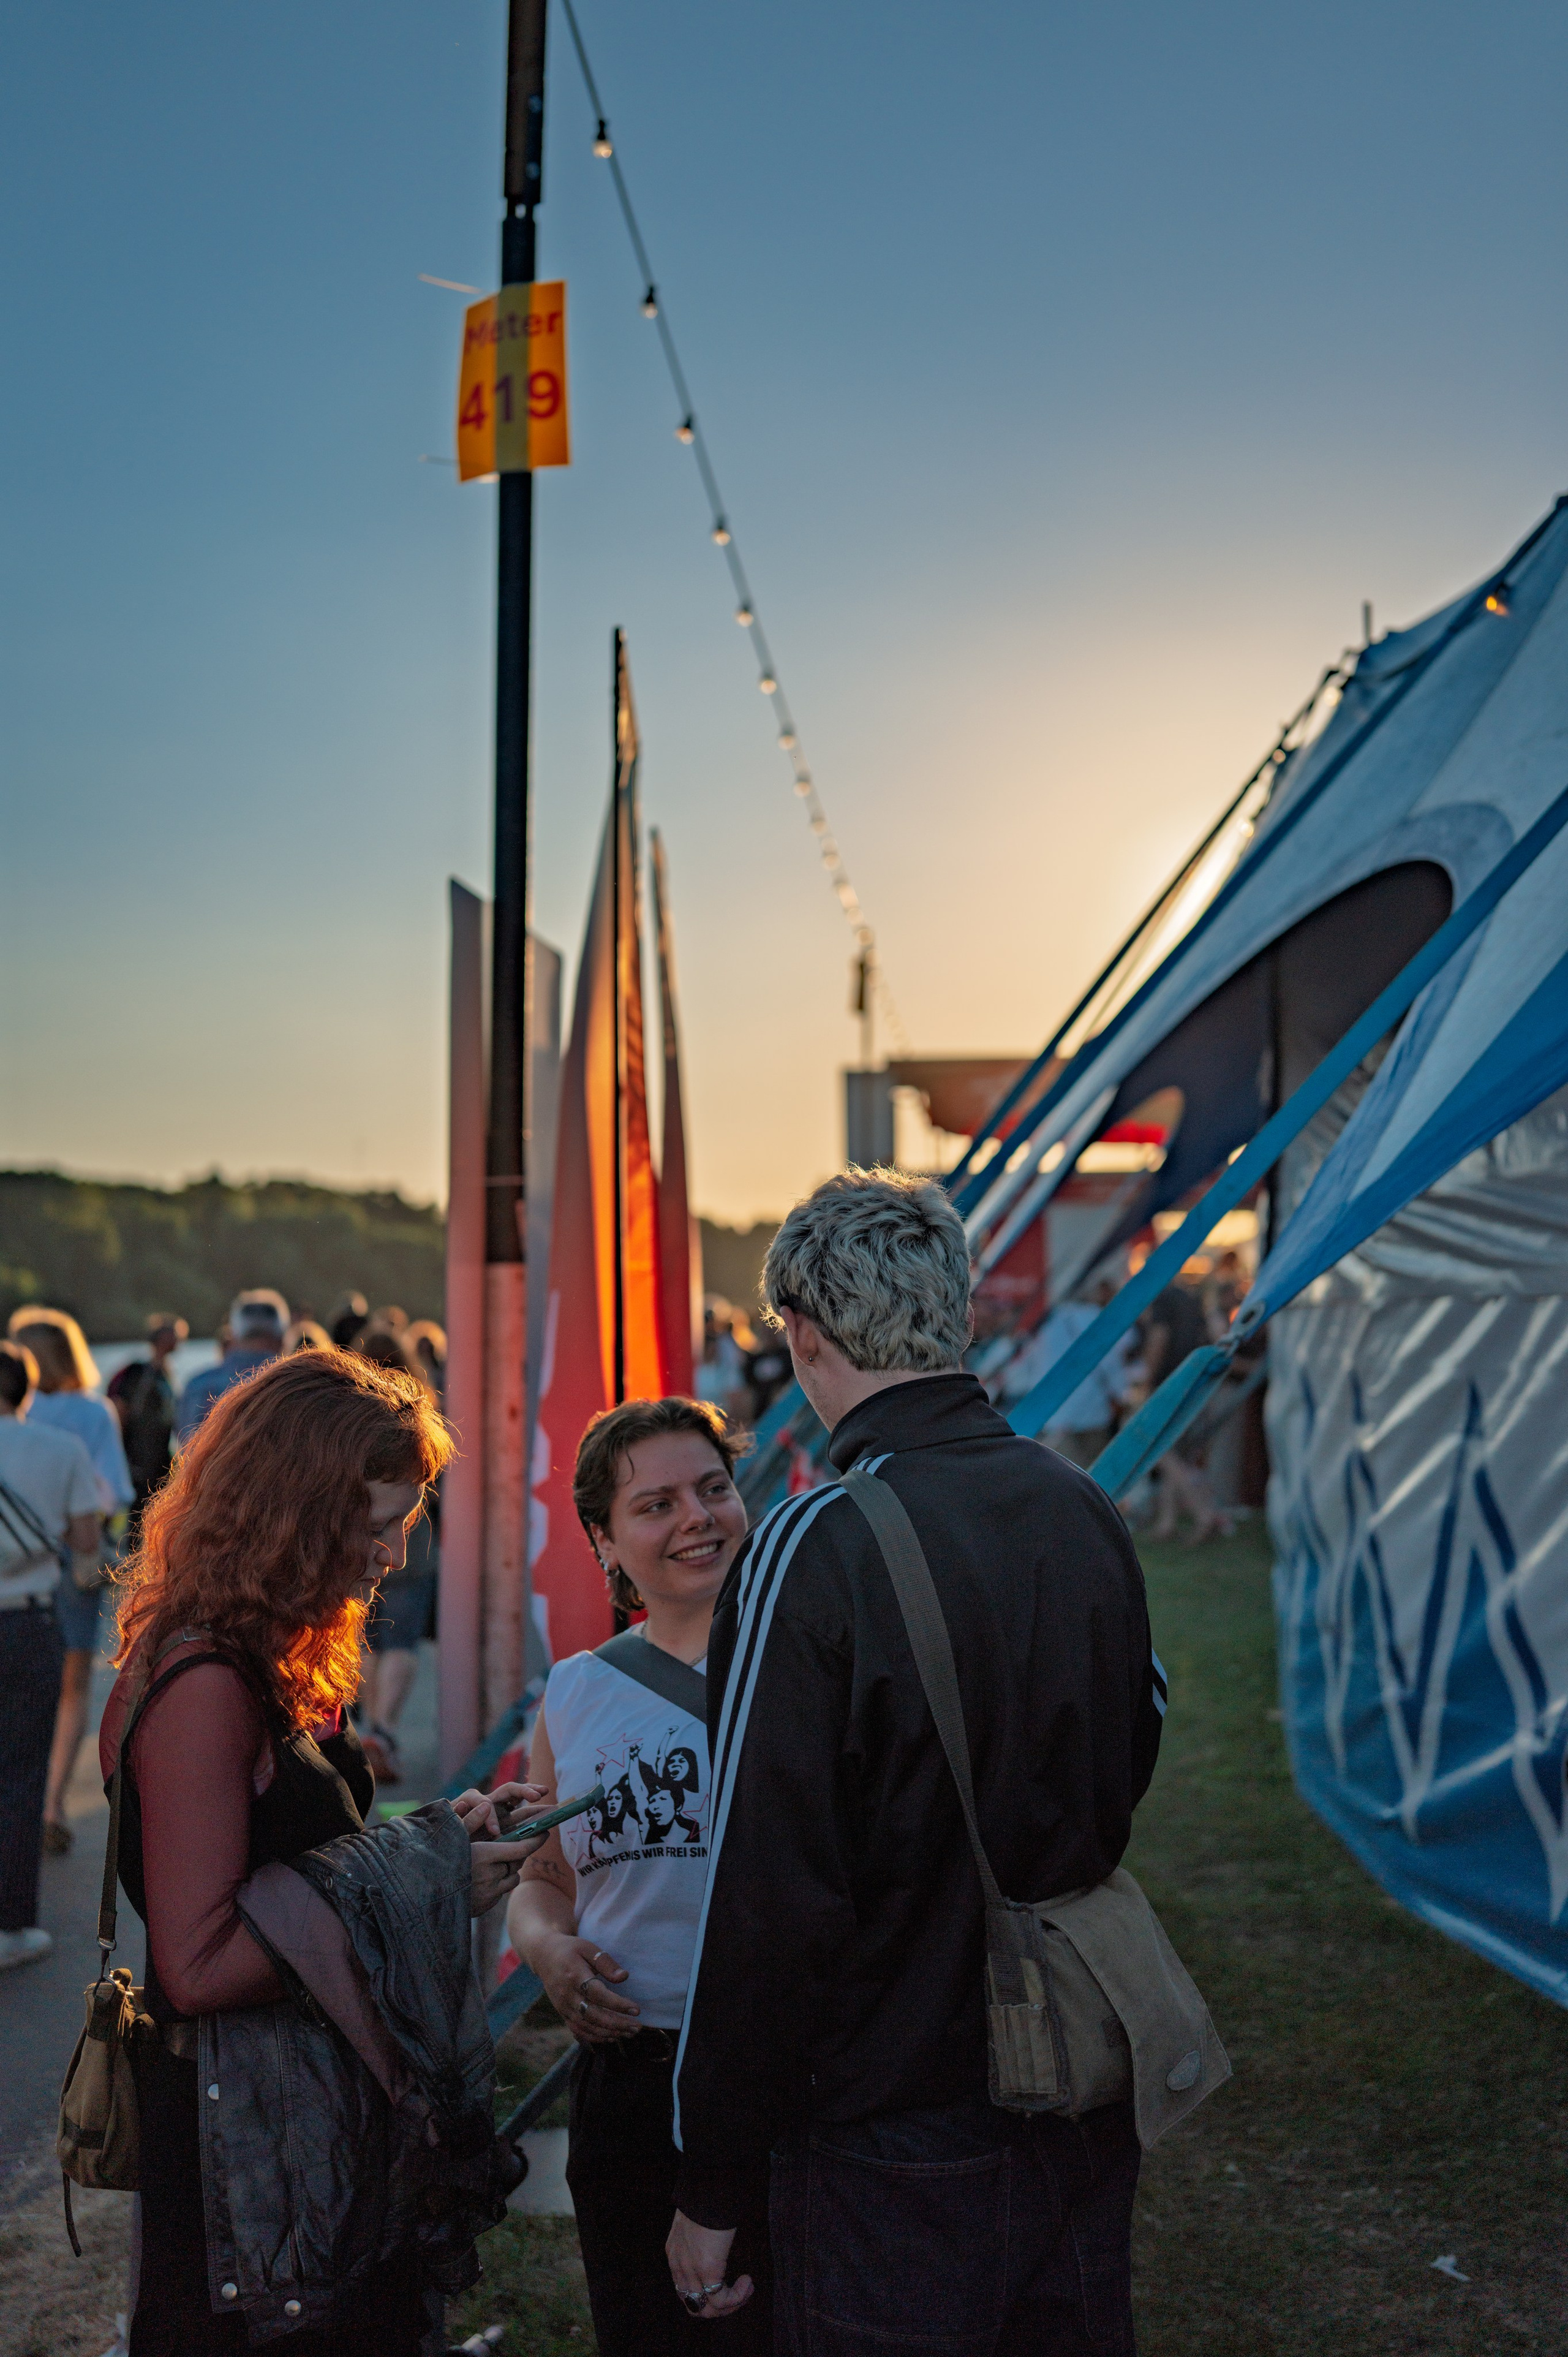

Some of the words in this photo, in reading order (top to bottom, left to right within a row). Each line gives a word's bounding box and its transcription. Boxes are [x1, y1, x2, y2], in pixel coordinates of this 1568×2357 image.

[467, 310, 562, 353] Meter
[460, 370, 560, 431] 419
[578, 1864, 595, 1877] WIR
[642, 1847, 664, 1858] WIR
[666, 1846, 687, 1858] FREI
[689, 1847, 708, 1858] SIN
